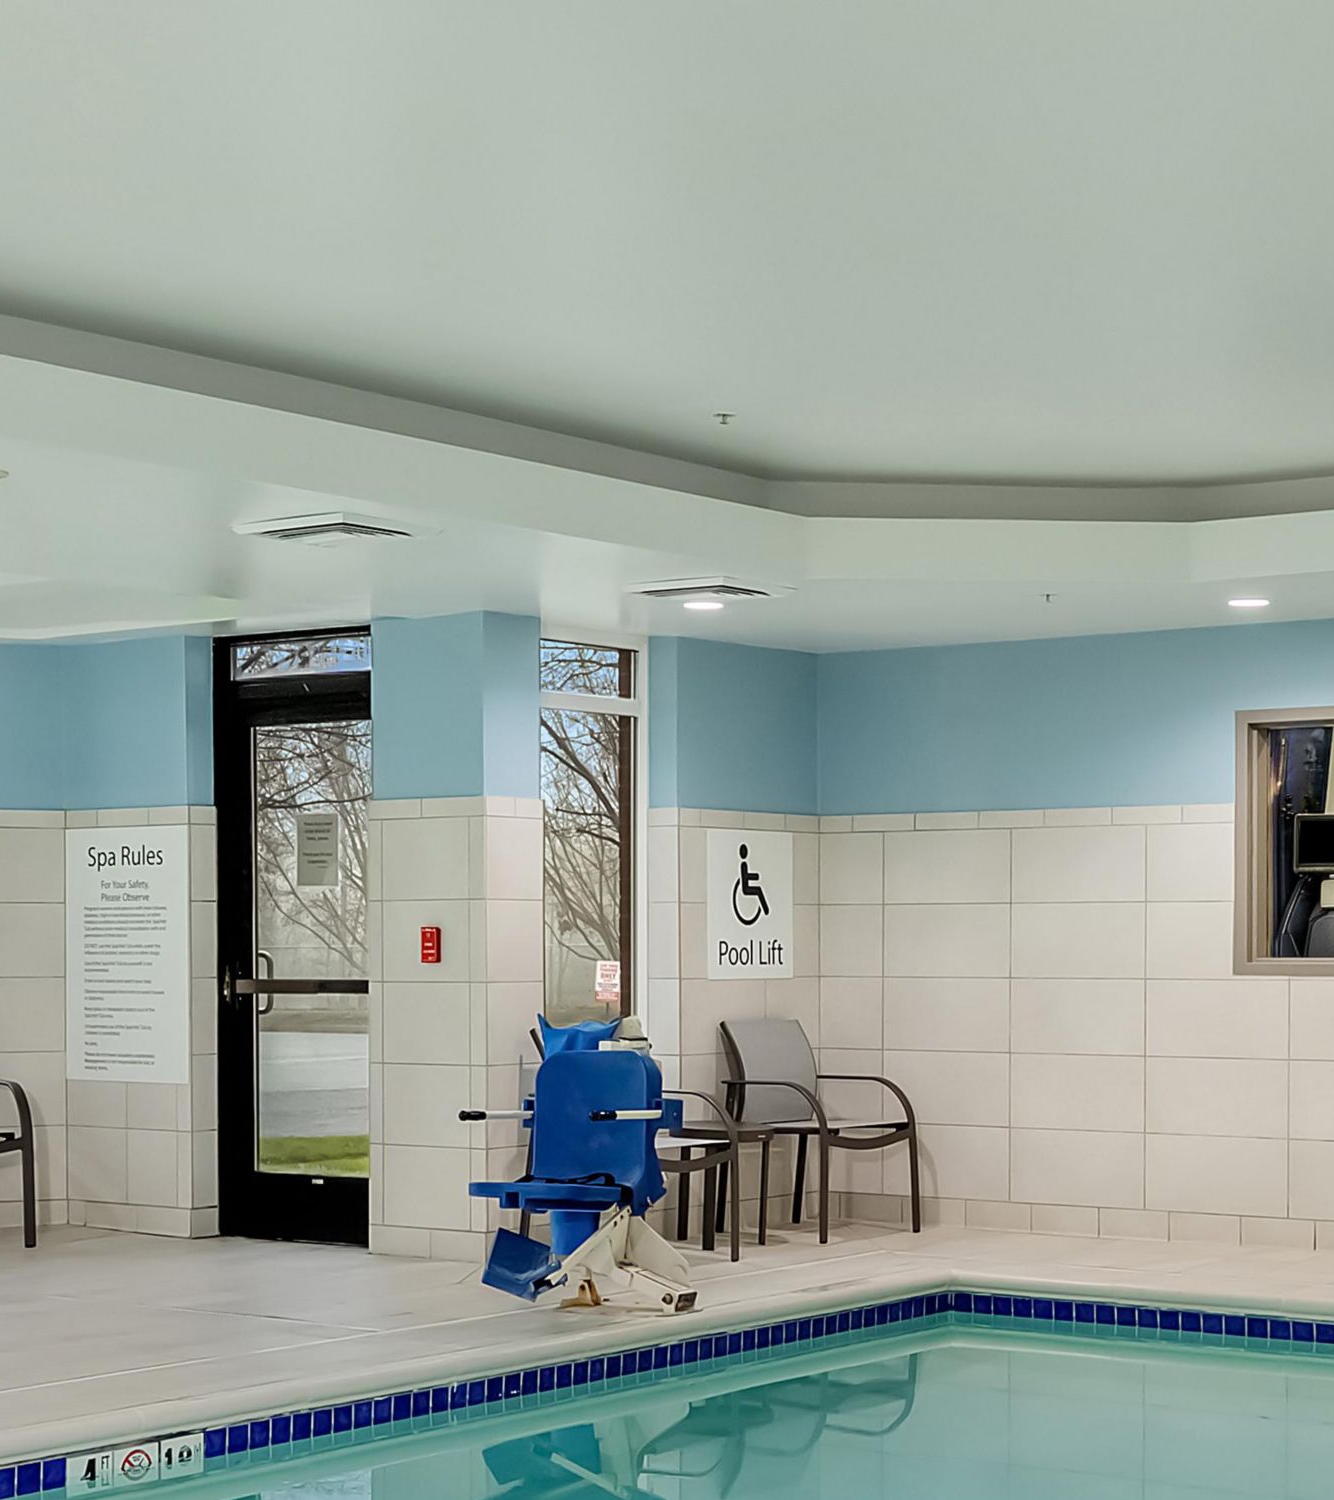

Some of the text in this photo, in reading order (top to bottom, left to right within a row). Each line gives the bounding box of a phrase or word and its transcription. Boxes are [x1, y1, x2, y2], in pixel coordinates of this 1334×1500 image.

[87, 844, 164, 872] Spa Rules
[718, 939, 784, 966] Pool Lift
